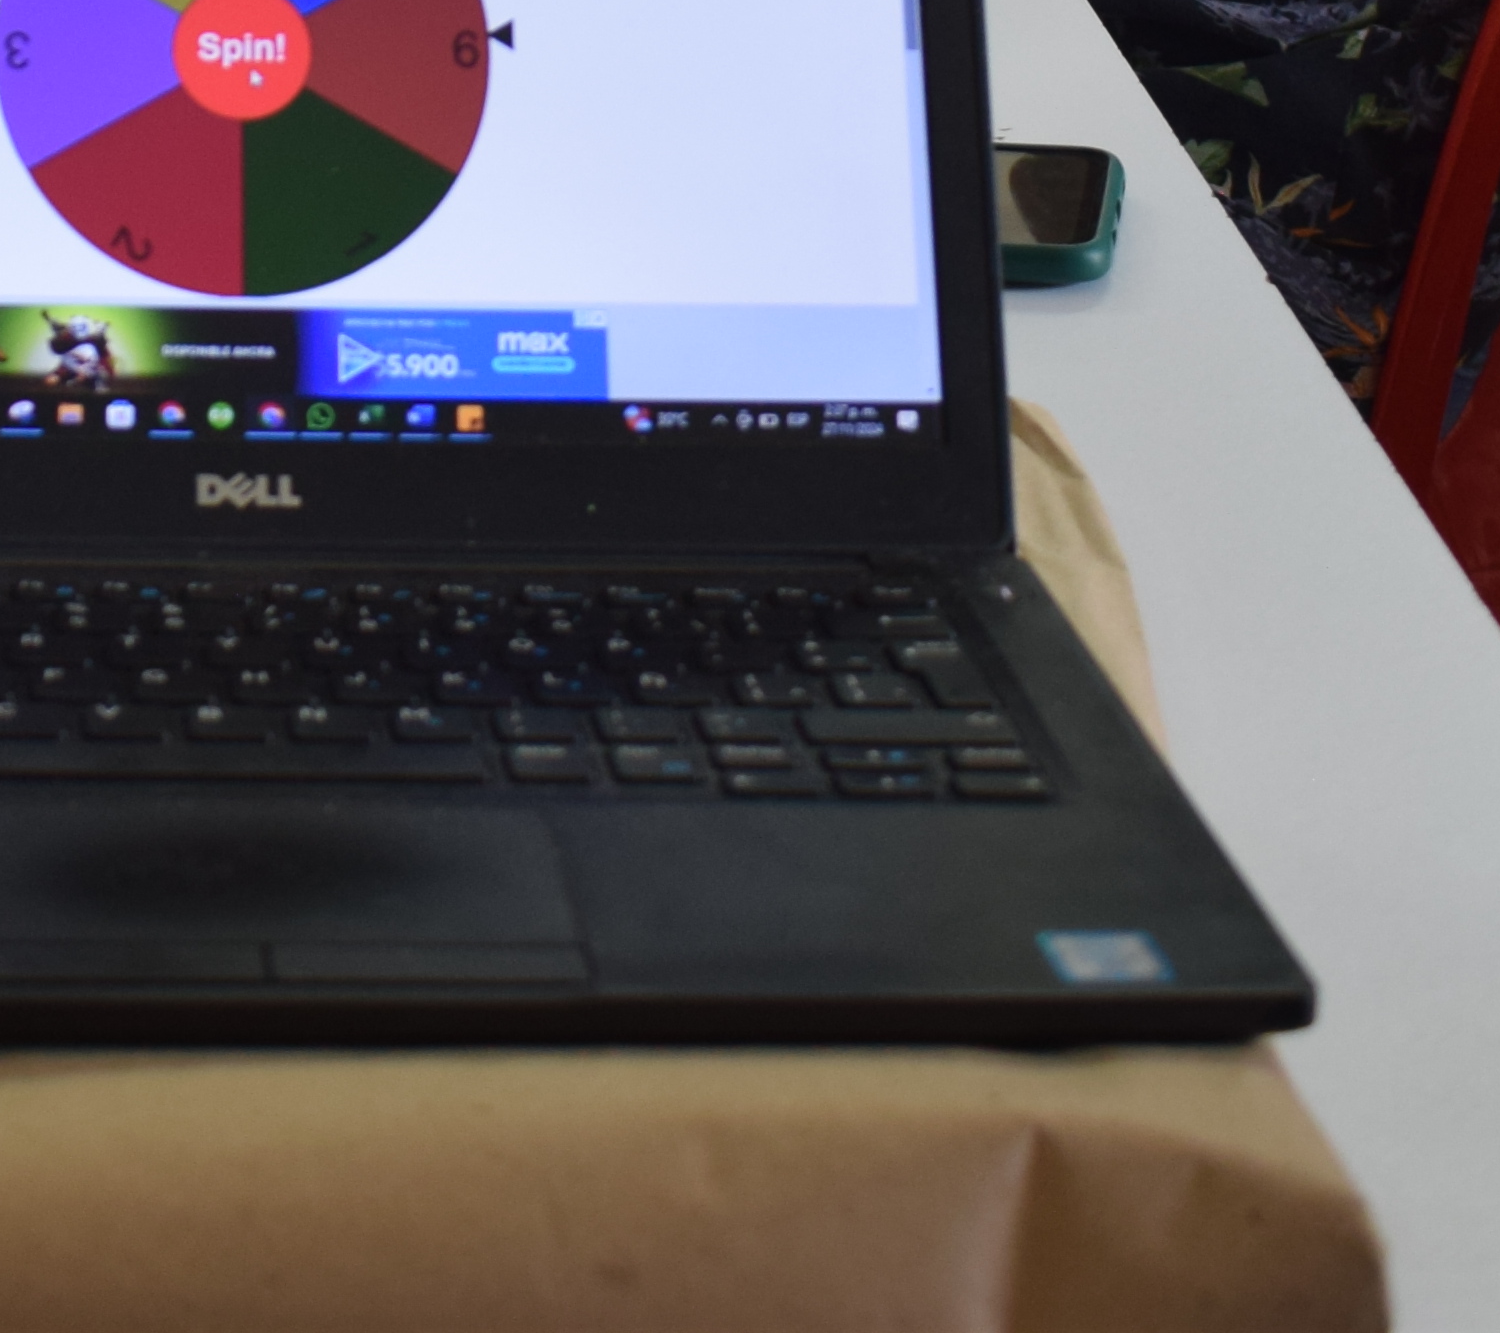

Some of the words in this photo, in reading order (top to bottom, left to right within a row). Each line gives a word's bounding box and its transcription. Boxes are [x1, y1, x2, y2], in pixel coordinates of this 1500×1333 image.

[4, 31, 30, 70] 3
[196, 32, 287, 69] Spin!
[452, 29, 480, 69] 6
[109, 226, 155, 264] 2
[345, 230, 378, 258] 1
[497, 331, 570, 354] max
[195, 473, 301, 509] DELL
